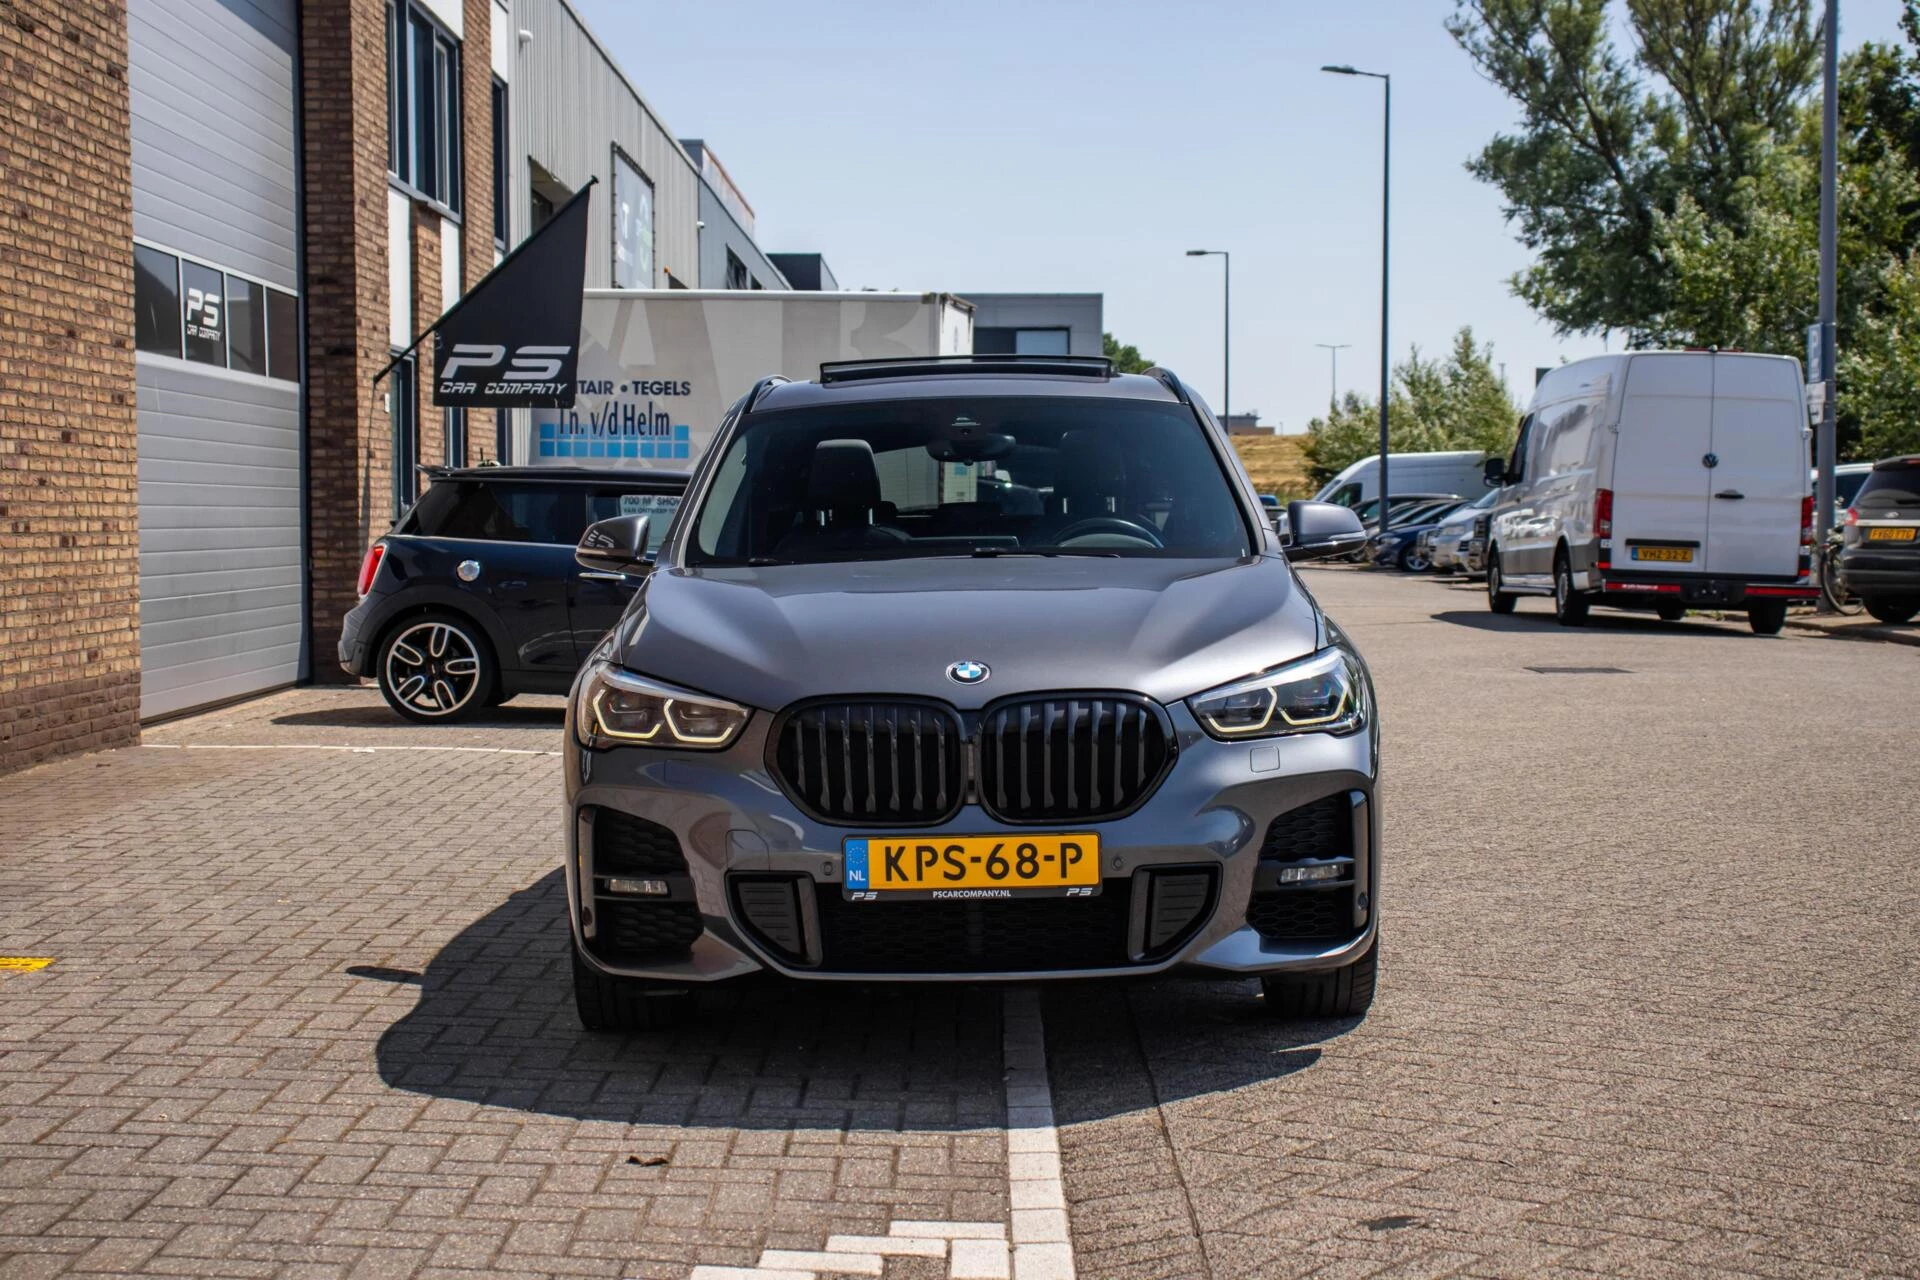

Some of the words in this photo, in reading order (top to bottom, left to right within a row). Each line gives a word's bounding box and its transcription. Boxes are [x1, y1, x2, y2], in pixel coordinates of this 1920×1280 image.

[186, 287, 220, 327] PS
[187, 323, 198, 336] CAR
[198, 326, 221, 342] COMPANY
[440, 343, 572, 380] PS
[439, 382, 477, 394] CAR
[484, 383, 567, 394] COMPANY
[576, 380, 614, 395] TAIR
[632, 380, 691, 396] TEGELS
[623, 401, 670, 436] Helm
[849, 869, 866, 881] NL
[884, 842, 1083, 882] KPS-68-P
[851, 891, 878, 900] PS
[932, 890, 1012, 898] PSCARCOMPANY.NL
[1066, 887, 1093, 897] PS
